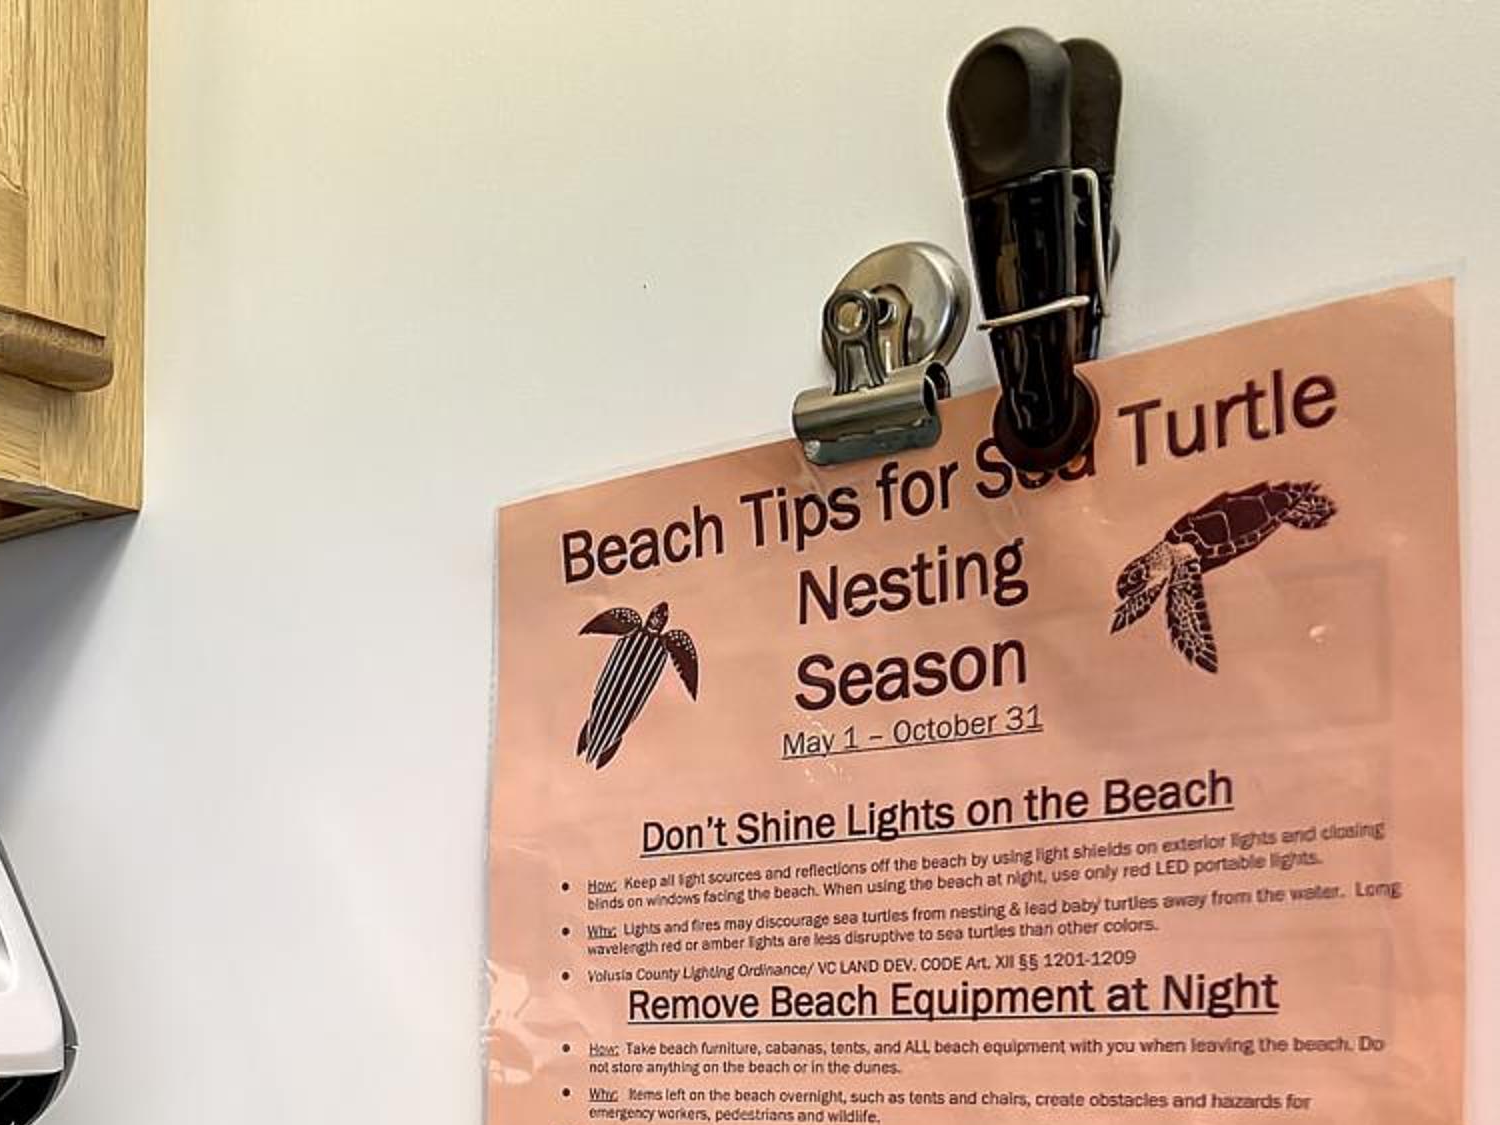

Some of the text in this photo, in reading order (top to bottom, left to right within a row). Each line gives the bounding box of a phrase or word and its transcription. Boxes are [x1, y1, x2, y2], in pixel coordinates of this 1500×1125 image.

[562, 503, 725, 582] Beach
[740, 485, 861, 552] Tips
[877, 461, 959, 520] for
[1119, 369, 1338, 469] Turtle
[799, 536, 1030, 624] Nesting
[794, 638, 1027, 709] Season
[782, 731, 835, 757] May
[844, 725, 859, 749] 1
[893, 714, 998, 744] October
[1005, 704, 1044, 730] 31
[736, 809, 836, 846] Shine
[848, 798, 955, 844] Lights
[966, 800, 1013, 828] on
[1023, 787, 1089, 823] the
[1104, 769, 1232, 816] Beach
[587, 966, 633, 982] Volusia
[635, 964, 681, 983] County
[682, 962, 735, 982] Lighting
[817, 958, 837, 974] VC
[839, 957, 880, 973] LAND
[883, 957, 917, 972] DEV.
[920, 955, 963, 971] CODE
[1043, 948, 1137, 967] 1201-1209
[629, 976, 1280, 1022] Remove Beach Equipment at Night
[589, 1058, 902, 1077] not store anything on the beach or in the dunes.
[588, 1106, 881, 1125] emergency workers, pedestrians and wildlife.
